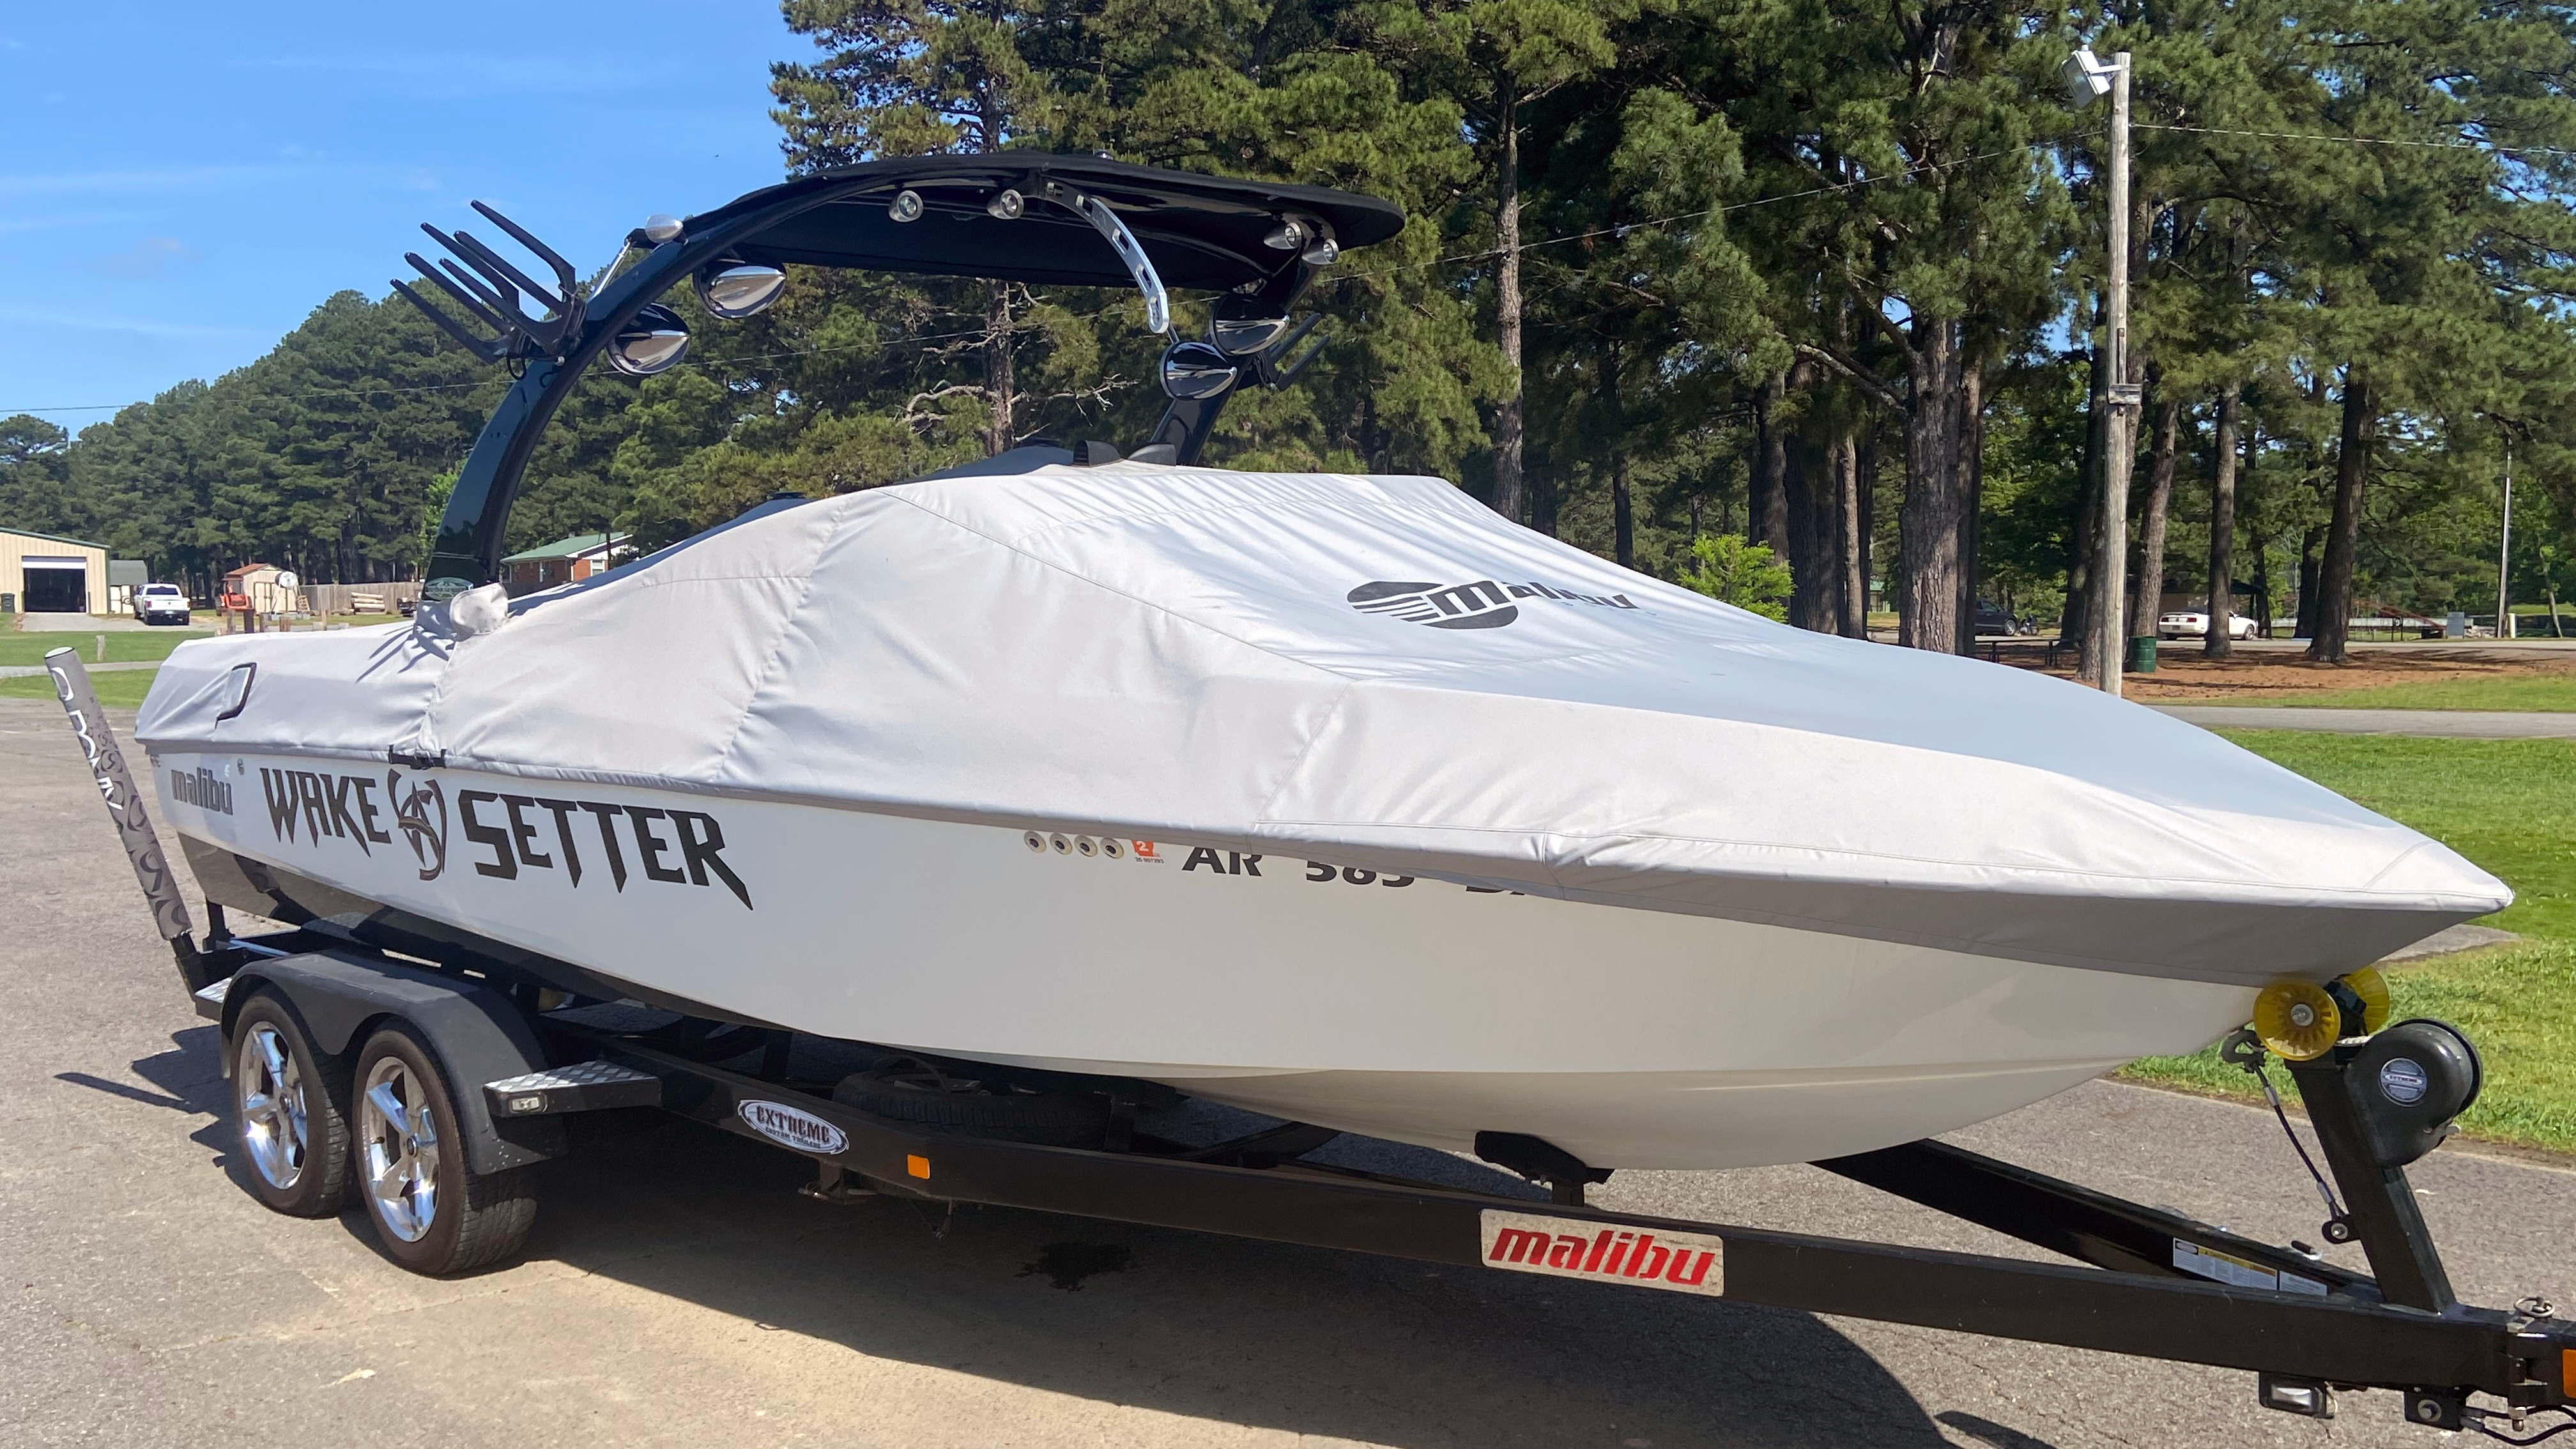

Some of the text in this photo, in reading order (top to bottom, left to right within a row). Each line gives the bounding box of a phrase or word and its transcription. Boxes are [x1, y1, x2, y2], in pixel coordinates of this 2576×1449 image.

[171, 767, 233, 815] malibu
[259, 767, 753, 910] WAKE SETTER
[1181, 847, 1262, 877] AR
[1489, 1228, 1715, 1286] malibu
